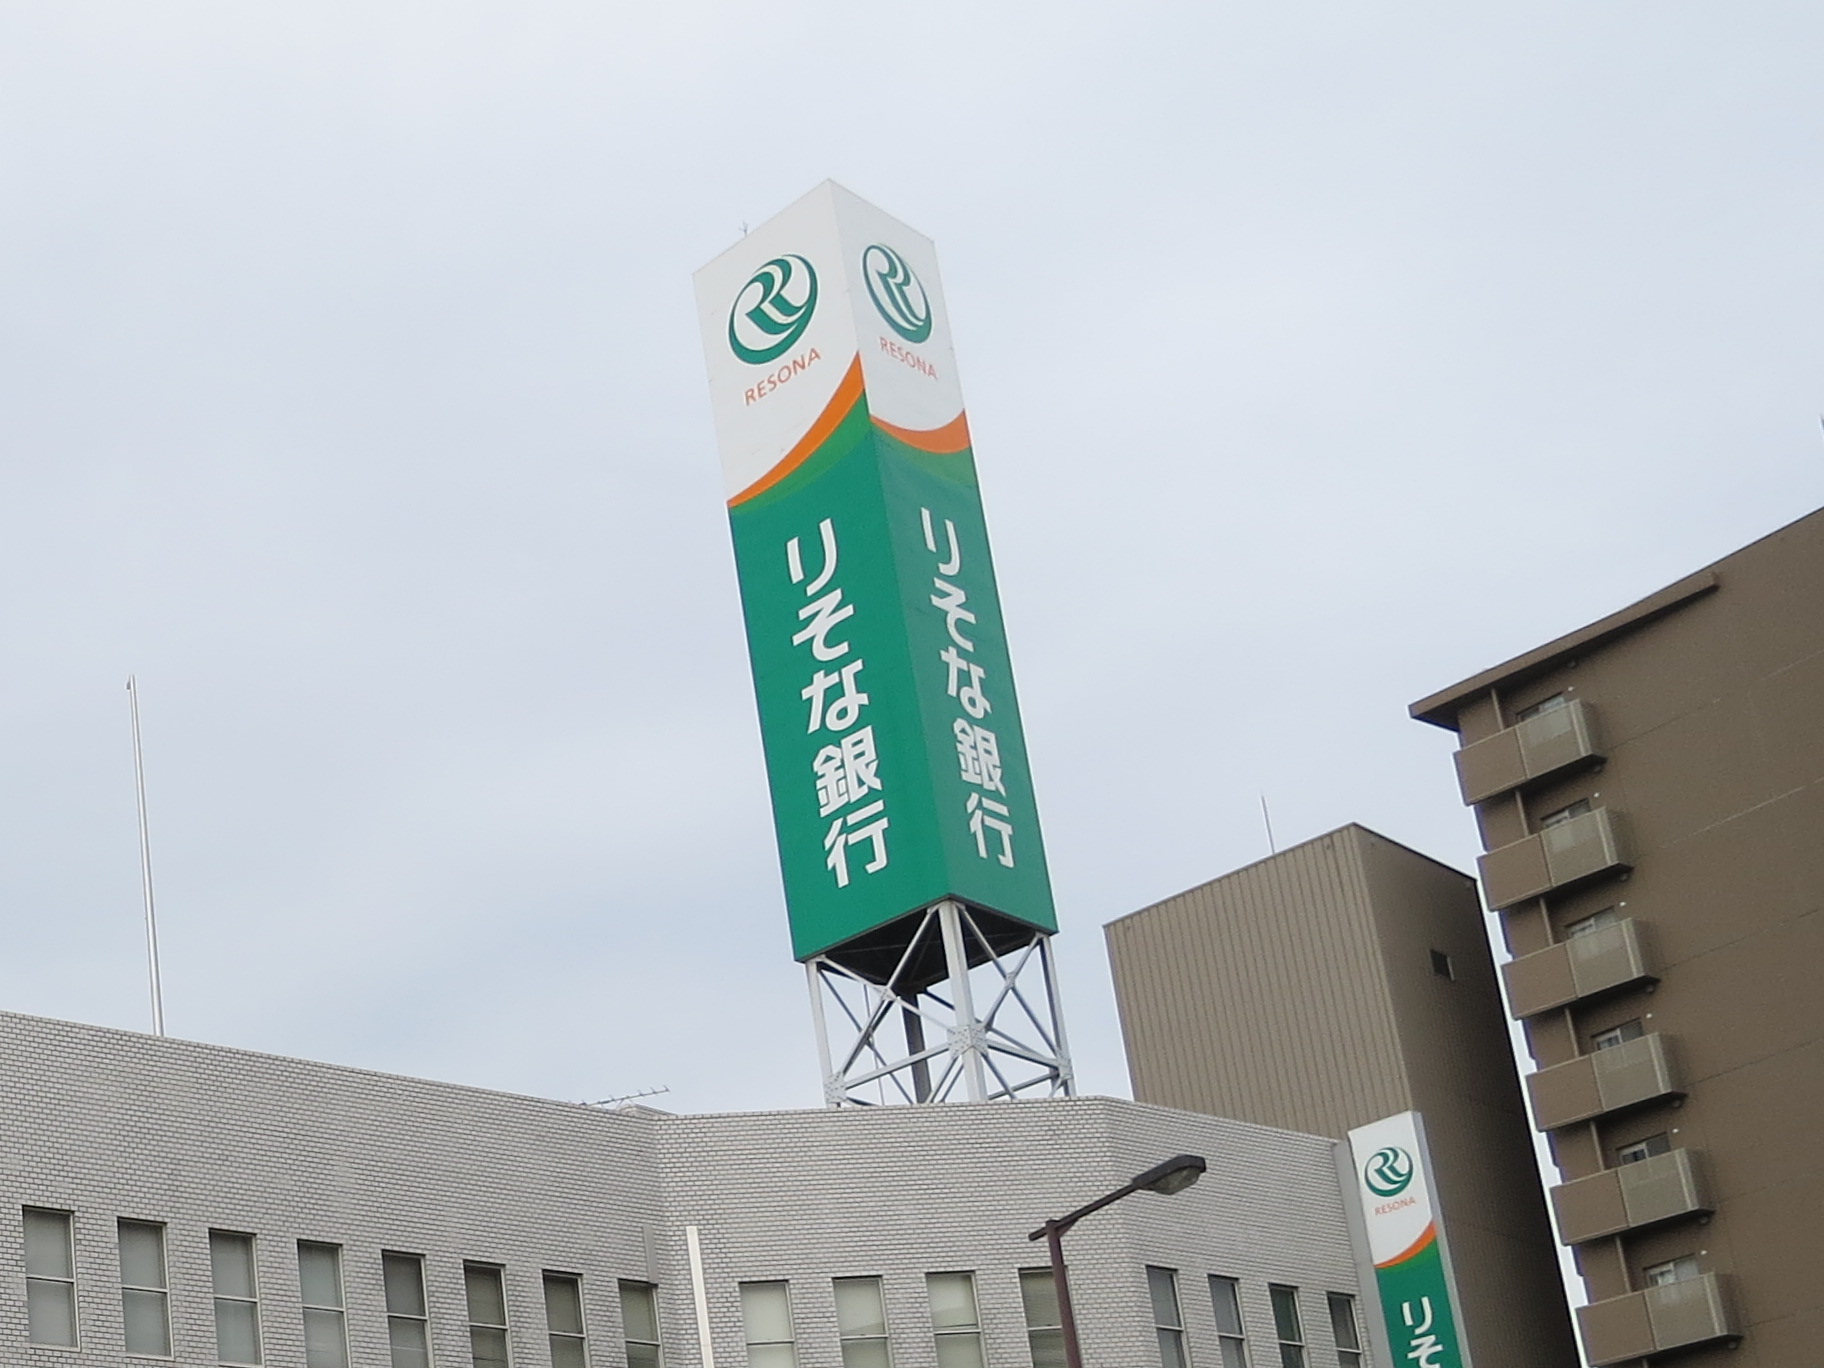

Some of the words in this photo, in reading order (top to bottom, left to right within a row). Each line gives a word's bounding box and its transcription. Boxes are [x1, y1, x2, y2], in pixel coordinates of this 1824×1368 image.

[744, 347, 822, 407] RESONA
[877, 336, 938, 381] RESONA
[785, 517, 891, 889] りそな銀行
[919, 507, 1015, 868] りそな銀行
[1374, 1196, 1417, 1217] RESONA
